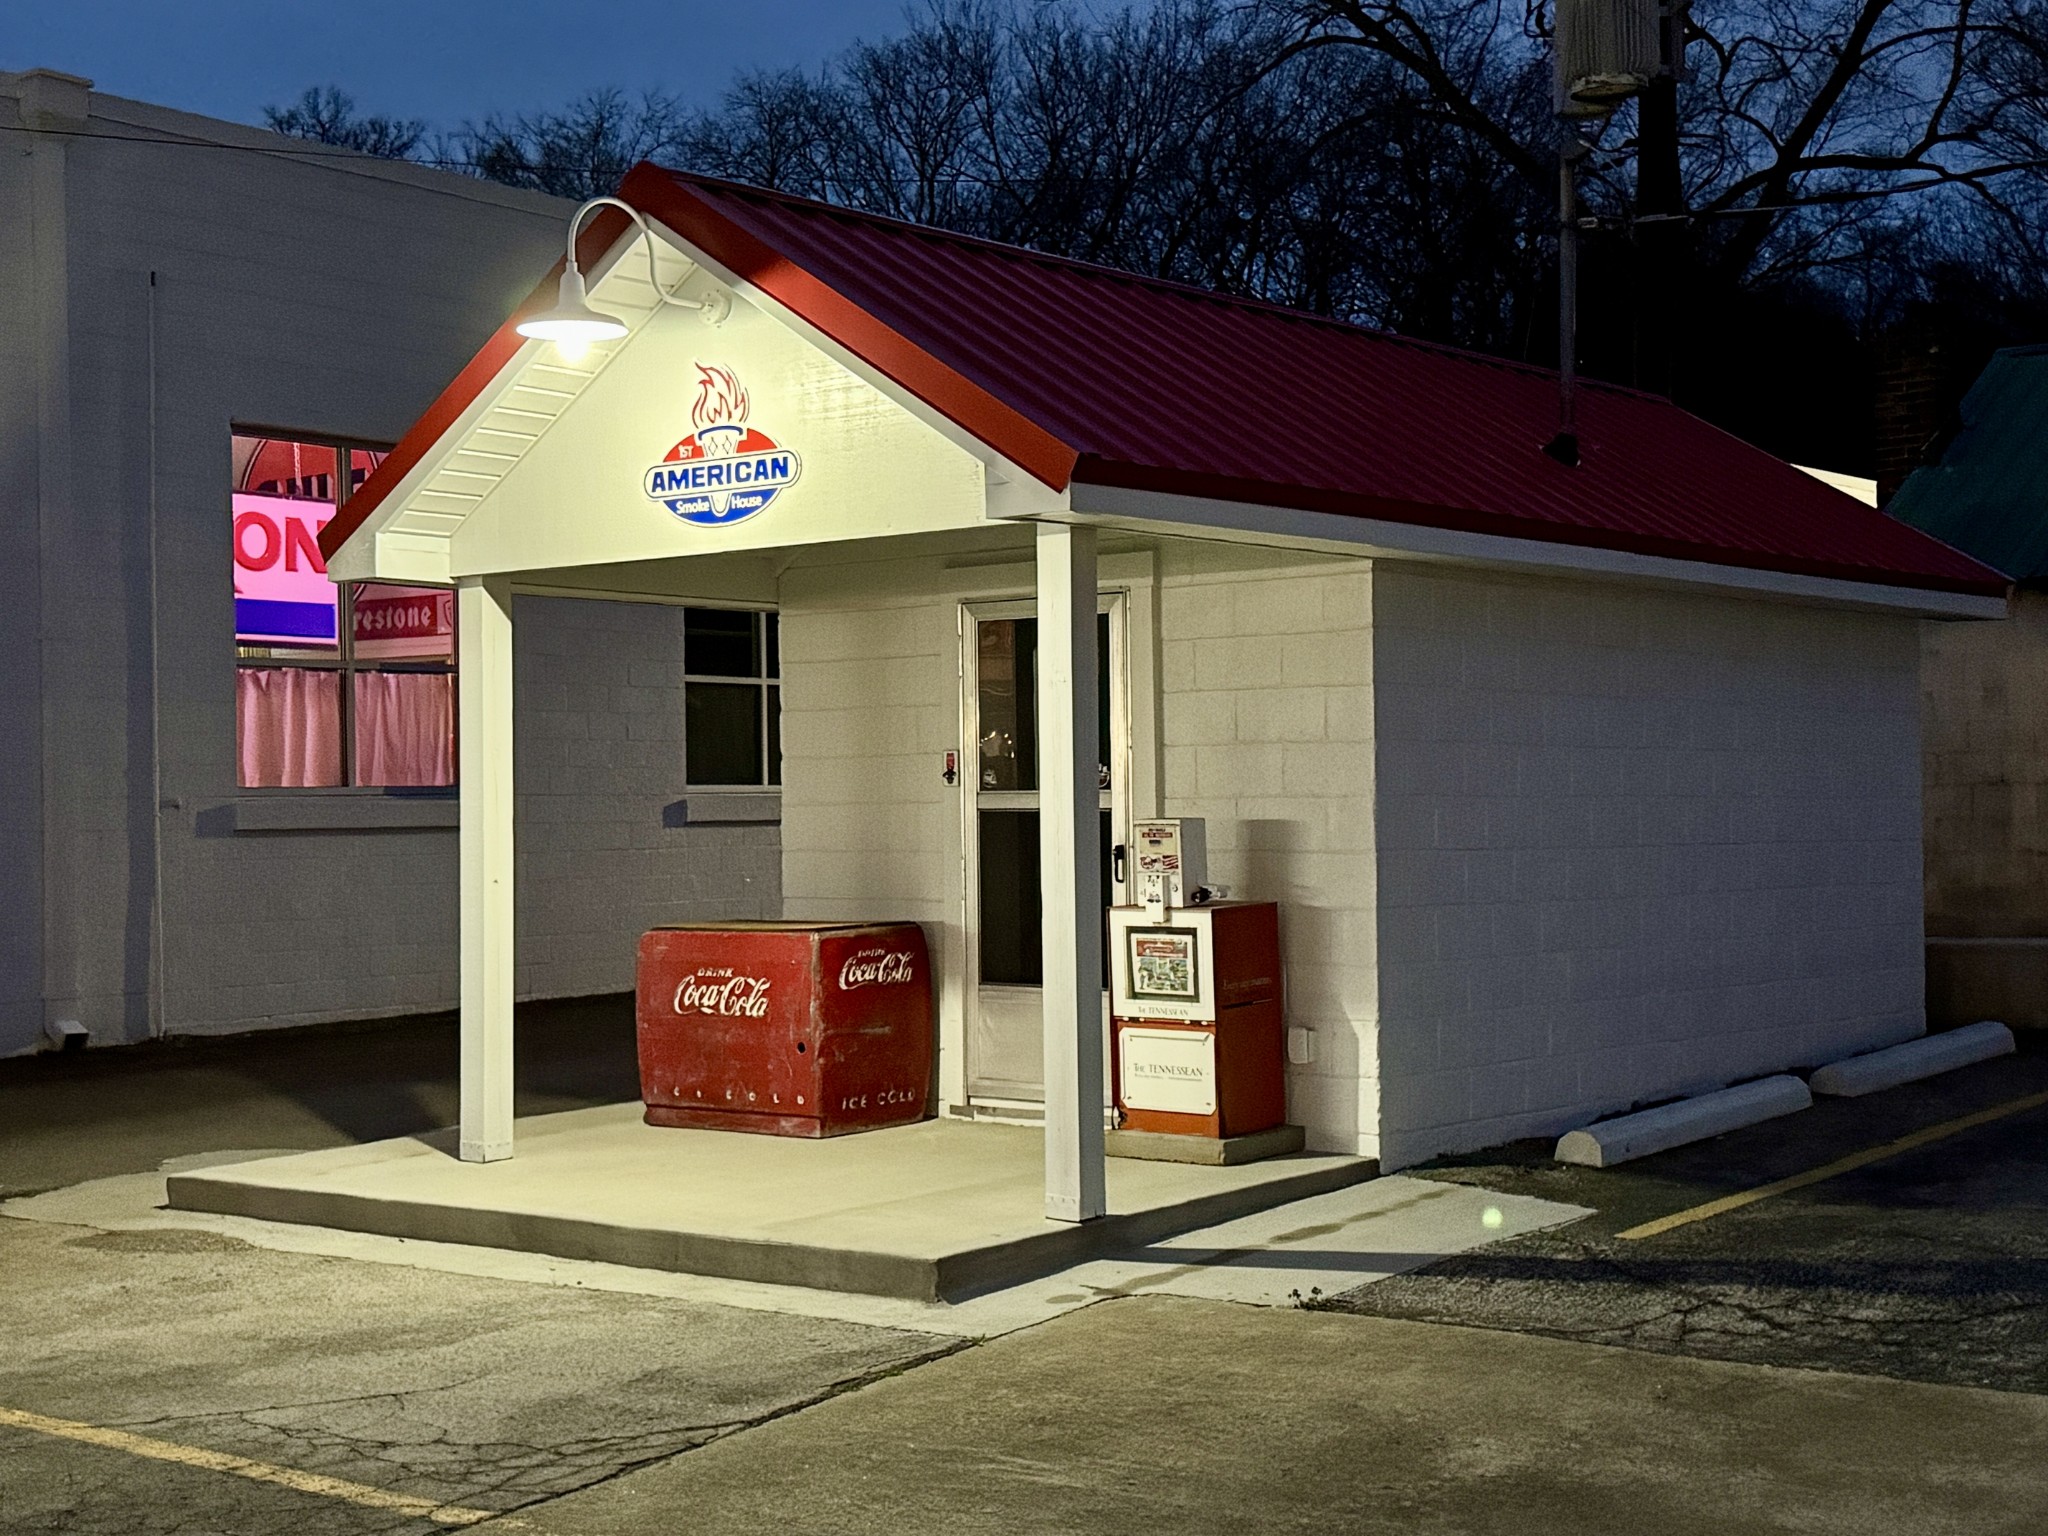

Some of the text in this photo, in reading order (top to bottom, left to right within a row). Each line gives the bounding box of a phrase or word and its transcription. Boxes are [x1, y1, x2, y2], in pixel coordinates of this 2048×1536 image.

[651, 456, 789, 493] AMERICAN
[676, 495, 763, 515] Smoke House
[697, 967, 734, 978] DRINK
[838, 951, 915, 990] Coca-Cola
[674, 975, 772, 1018] Coca-Cola
[1149, 1064, 1203, 1077] TENNESSEAN
[842, 1087, 916, 1111] ICE COLD
